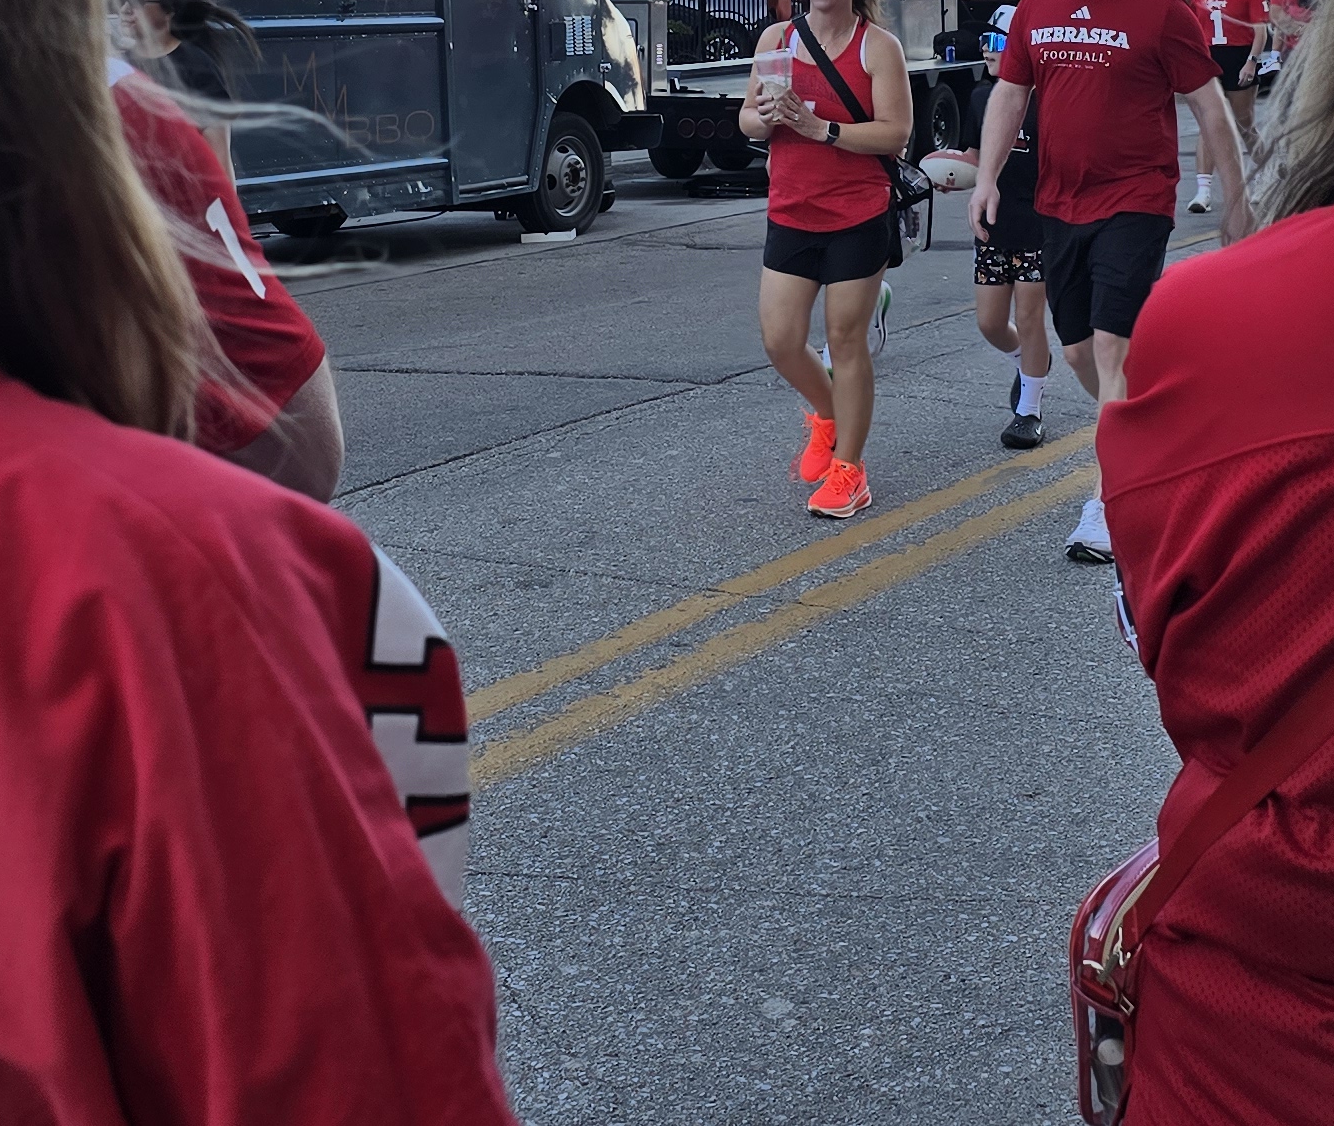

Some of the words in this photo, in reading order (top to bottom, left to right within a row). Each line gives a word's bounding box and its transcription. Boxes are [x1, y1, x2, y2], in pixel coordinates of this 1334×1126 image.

[1031, 26, 1130, 50] NEBRASKA
[1210, 10, 1228, 45] 1
[1043, 50, 1105, 63] FOOTBALL
[346, 110, 435, 148] BBQ
